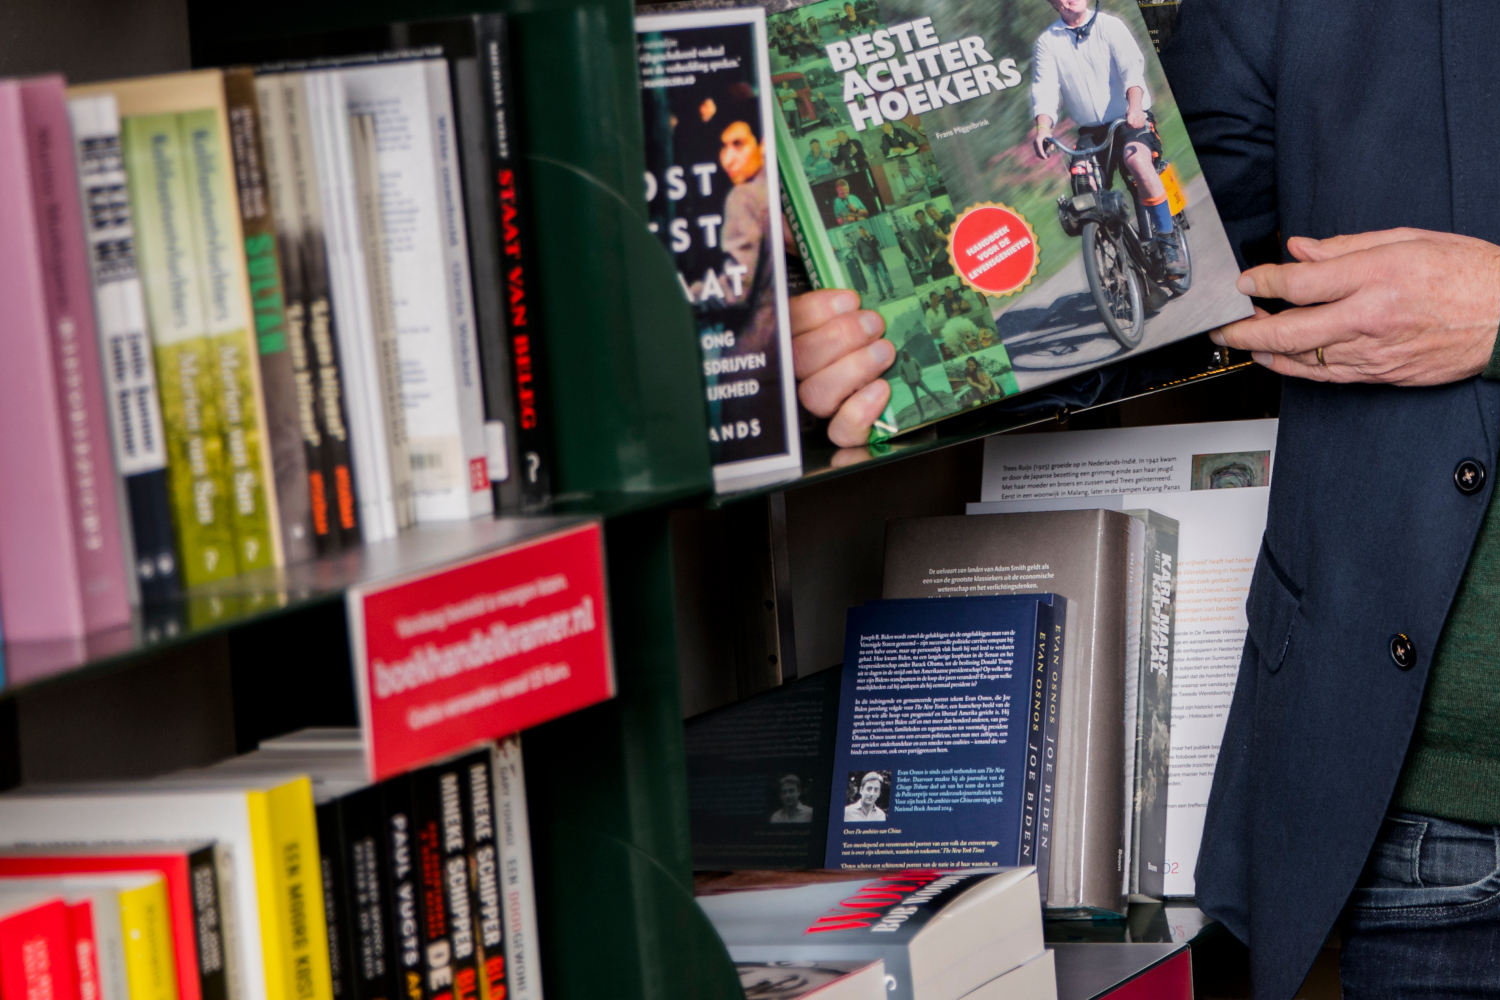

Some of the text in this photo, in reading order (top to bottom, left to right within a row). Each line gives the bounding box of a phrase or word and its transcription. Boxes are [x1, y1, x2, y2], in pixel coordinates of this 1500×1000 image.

[825, 16, 940, 74] BESTE
[843, 35, 994, 103] ACHTER
[846, 58, 1023, 133] HOEKERS
[935, 118, 991, 141] Frans Miggelbrink
[966, 224, 1011, 257] HANDBOEK
[967, 236, 1031, 281] LEVENSGENIETER
[976, 237, 1012, 262] VOOR DE
[244, 231, 287, 355] SULTAN
[498, 168, 537, 430] STAAT VAN BELEG
[1003, 464, 1017, 472] Trees
[1018, 463, 1032, 472] Ruijs
[1033, 463, 1050, 472] (1925)
[1051, 461, 1072, 470] groeide
[1073, 461, 1081, 470] op
[1081, 460, 1087, 468] in
[1088, 457, 1138, 467] Nederlands-Indië.
[1145, 457, 1159, 465] 1942
[1160, 455, 1177, 463] kwam
[937, 584, 969, 593] wetenschap
[976, 583, 986, 591] het
[987, 582, 1039, 591] verlichtingsdenken.
[1149, 572, 1162, 673] KAPITAAL
[1157, 552, 1172, 679] KARL MARX
[372, 594, 596, 699] boekhandelkramer.nl
[1022, 631, 1046, 857] EVAN OSNOS JOE BIDEN
[1041, 624, 1062, 848] EVAN OSNOS JOE BIDEN
[392, 812, 420, 967] PAUL VUGTS
[439, 772, 474, 960] MINEKE SCHIPPER
[469, 761, 502, 948] MINEKE SCHIPPER
[500, 766, 528, 994] GARY YOUNGE EEN DOODGEWONE
[870, 905, 919, 933] BOB
